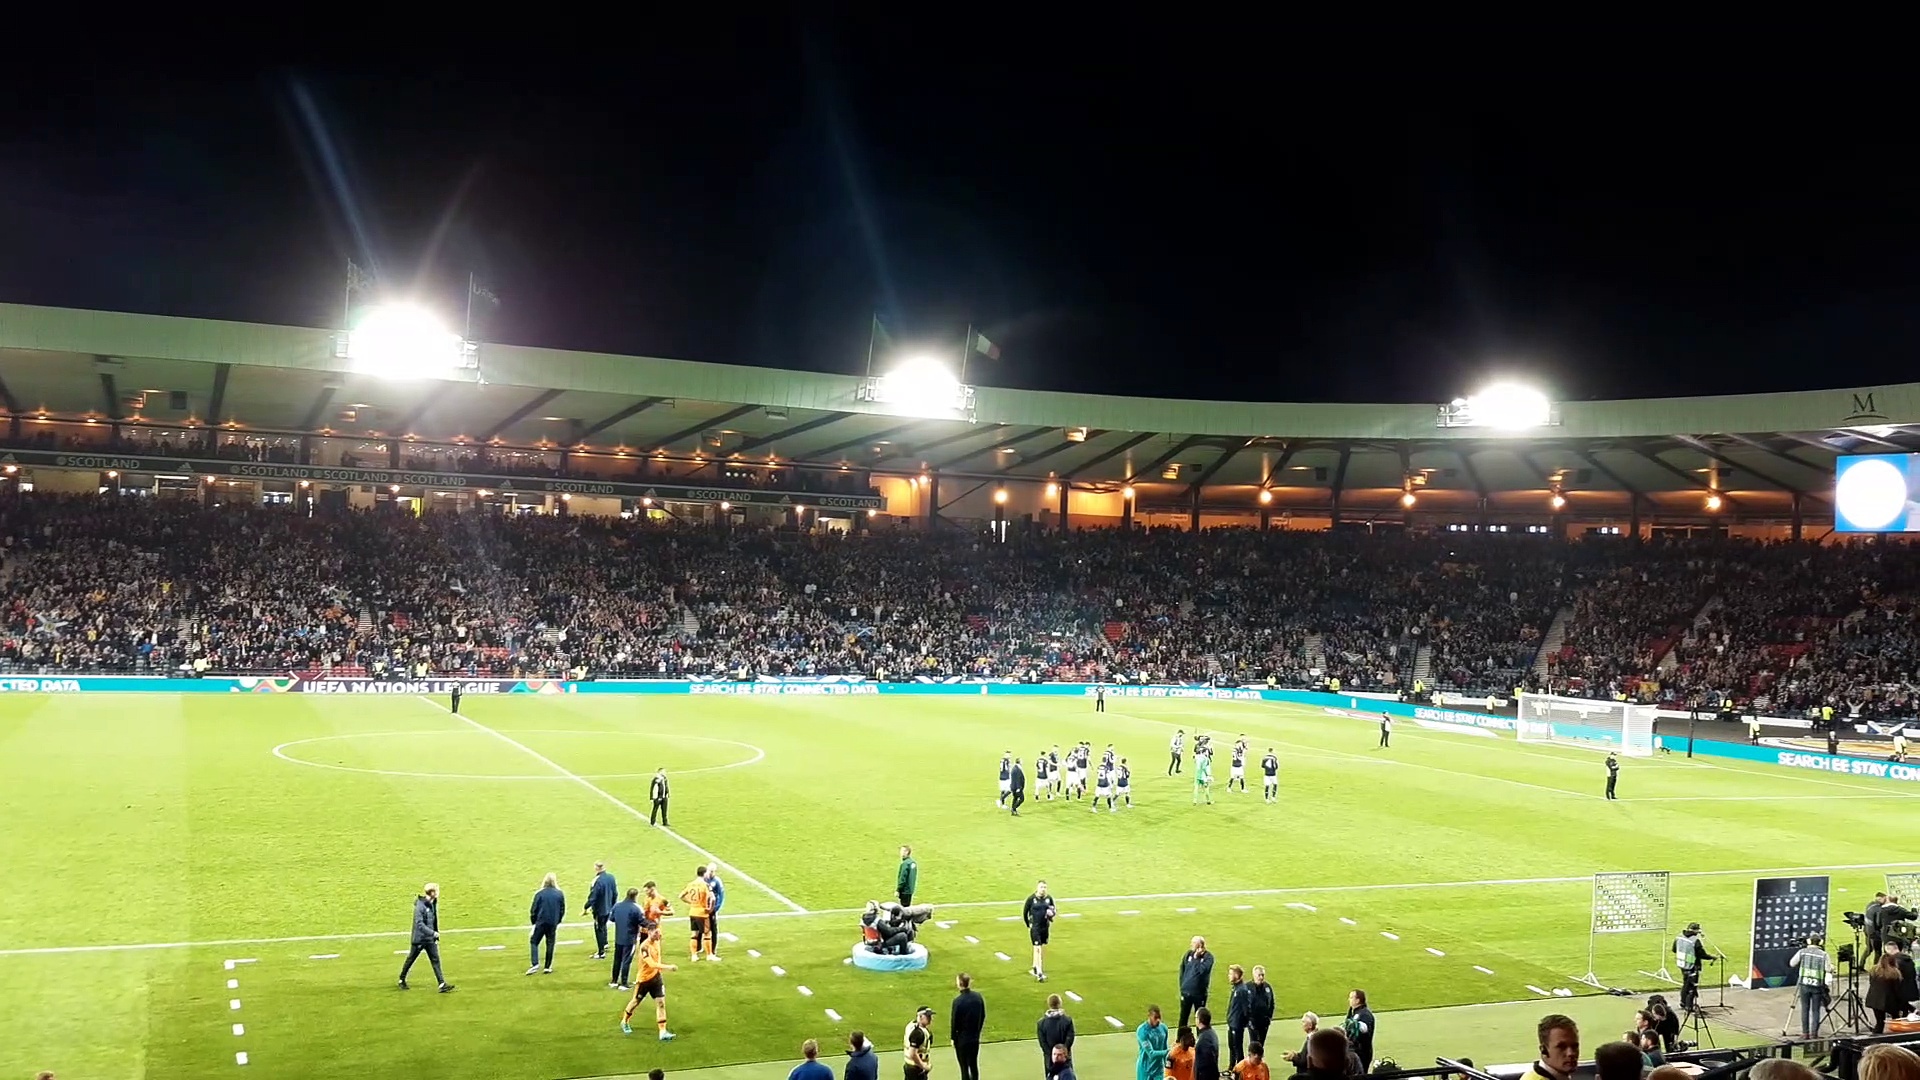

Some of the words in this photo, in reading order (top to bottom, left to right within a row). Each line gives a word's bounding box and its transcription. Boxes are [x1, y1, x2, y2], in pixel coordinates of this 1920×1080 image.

[1852, 392, 1876, 413] M
[41, 679, 81, 692] DATA
[303, 681, 348, 693] UEFA
[351, 681, 430, 693] NATIONS
[434, 682, 500, 693] LEGUE
[689, 684, 735, 694] SEARCH
[752, 684, 783, 694] STAY
[783, 684, 850, 694] CONNECTED
[850, 684, 879, 694] DATA
[1084, 686, 1125, 697] SERCH
[1140, 687, 1168, 698] STAY
[1233, 690, 1262, 700] DATA
[1778, 752, 1830, 771] SEARCH
[1831, 758, 1850, 773] EE
[1851, 760, 1889, 777] STAY
